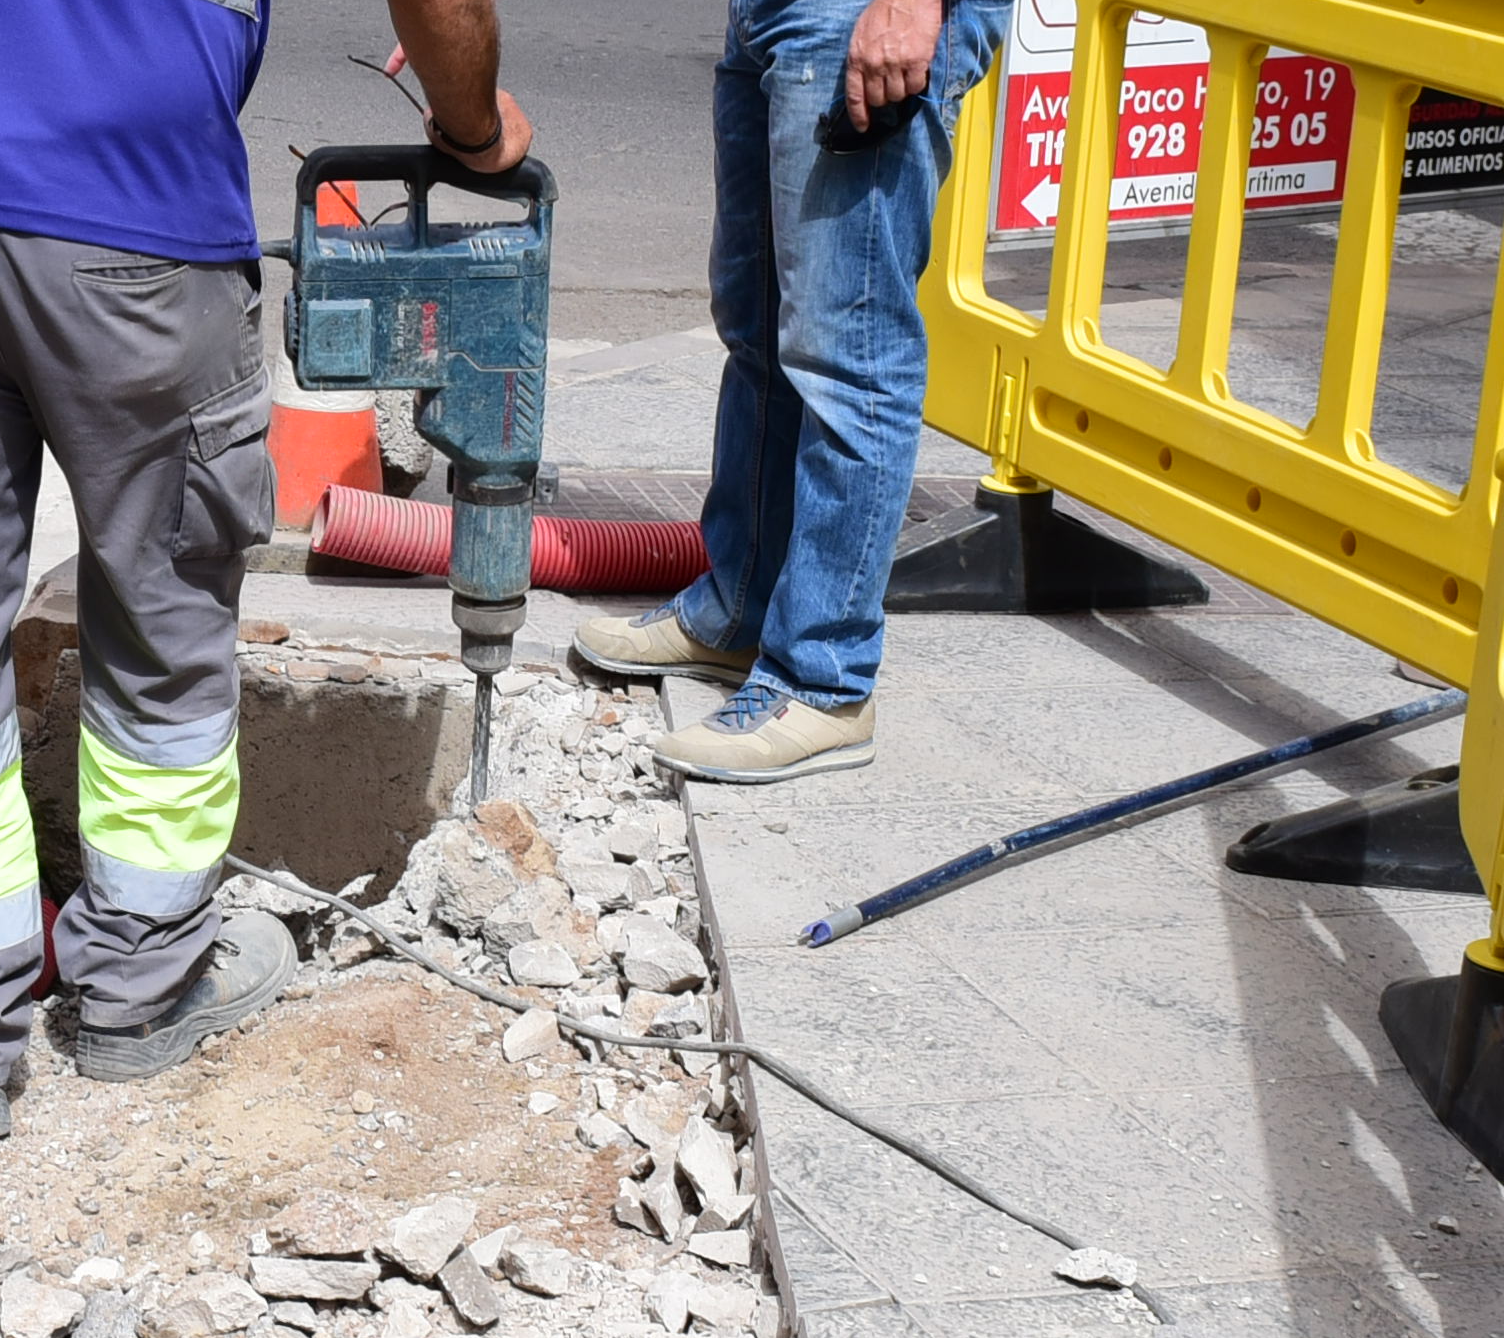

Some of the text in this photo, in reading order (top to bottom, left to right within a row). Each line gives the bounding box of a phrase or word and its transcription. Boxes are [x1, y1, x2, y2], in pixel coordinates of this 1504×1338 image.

[1119, 80, 1185, 115] Paco
[1304, 66, 1337, 102] 19
[1127, 122, 1186, 159] 928
[1290, 111, 1328, 148] 05
[1404, 128, 1456, 150] URSOS
[1416, 152, 1504, 177] ALIMENTOS
